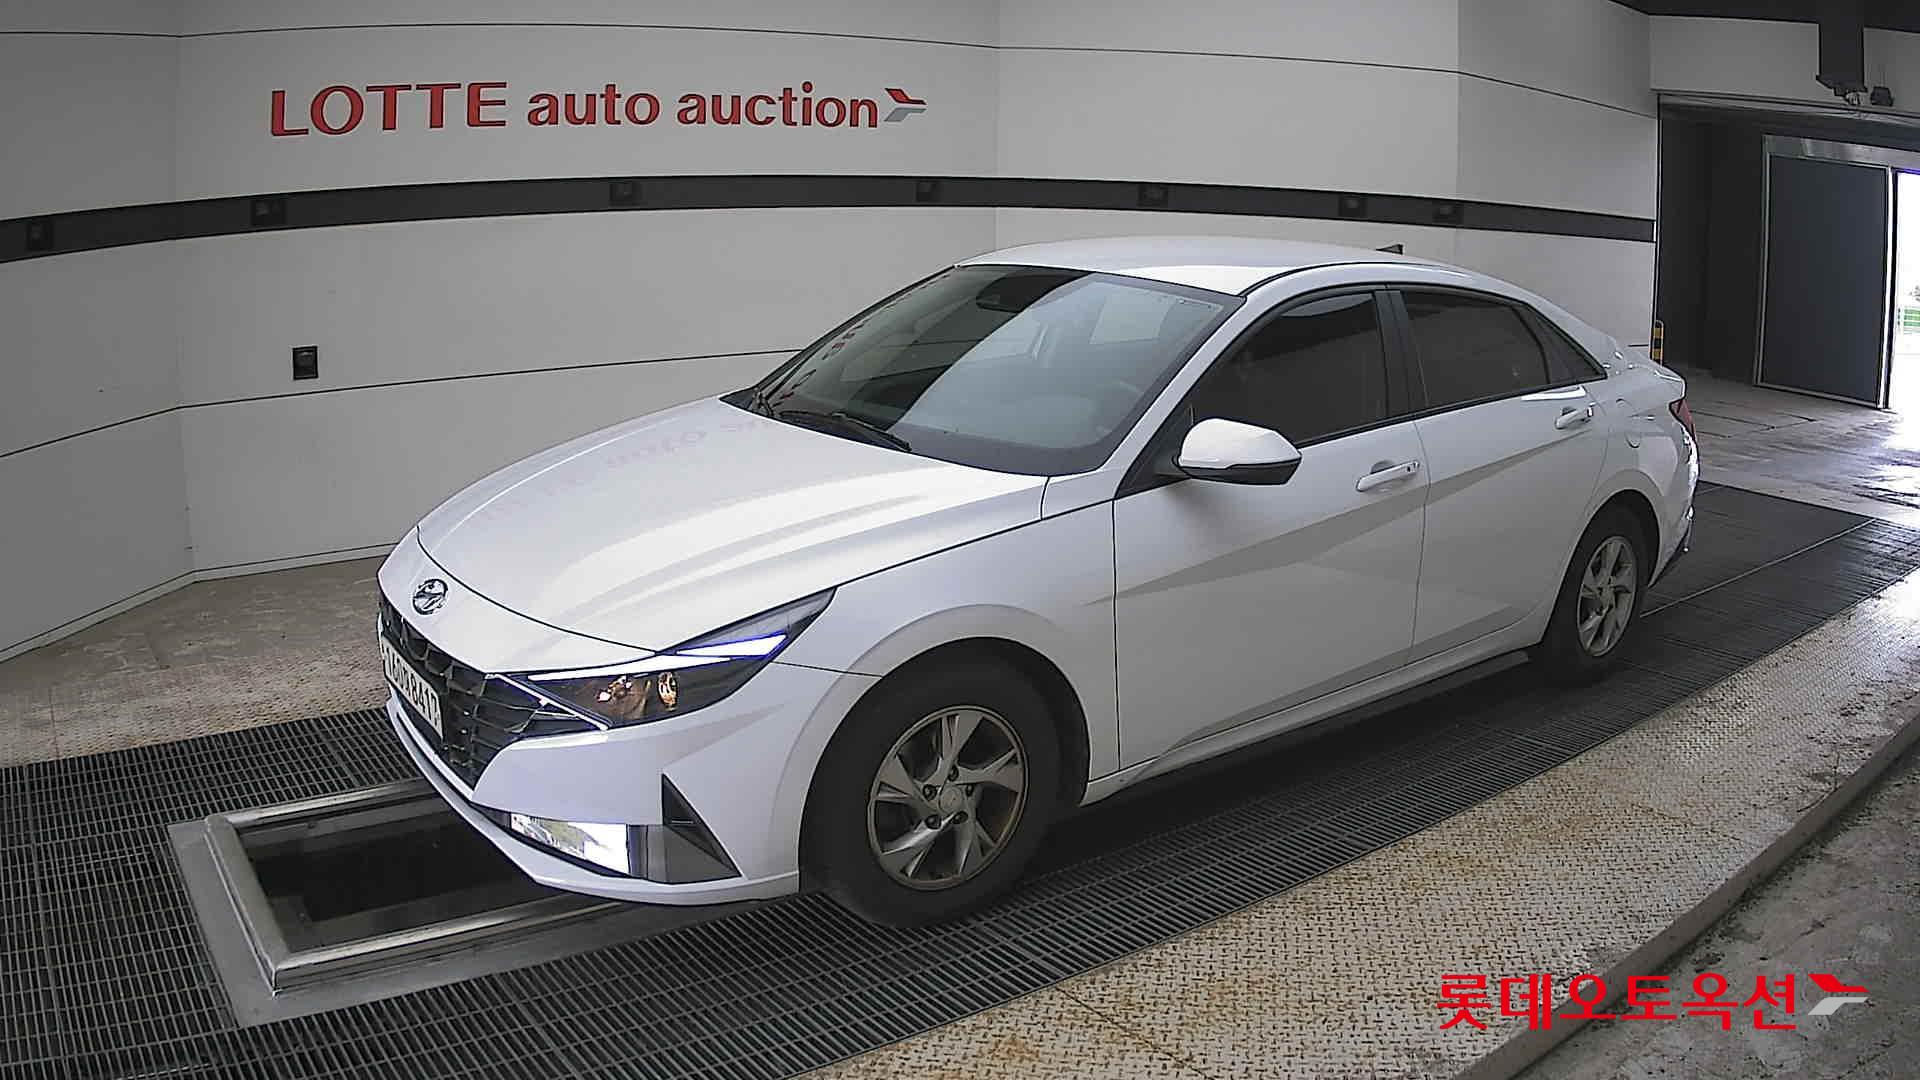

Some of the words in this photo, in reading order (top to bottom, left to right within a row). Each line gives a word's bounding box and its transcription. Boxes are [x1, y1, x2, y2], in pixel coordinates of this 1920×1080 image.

[271, 83, 508, 136] LOTTE
[527, 83, 661, 126] auto
[676, 81, 879, 127] auction
